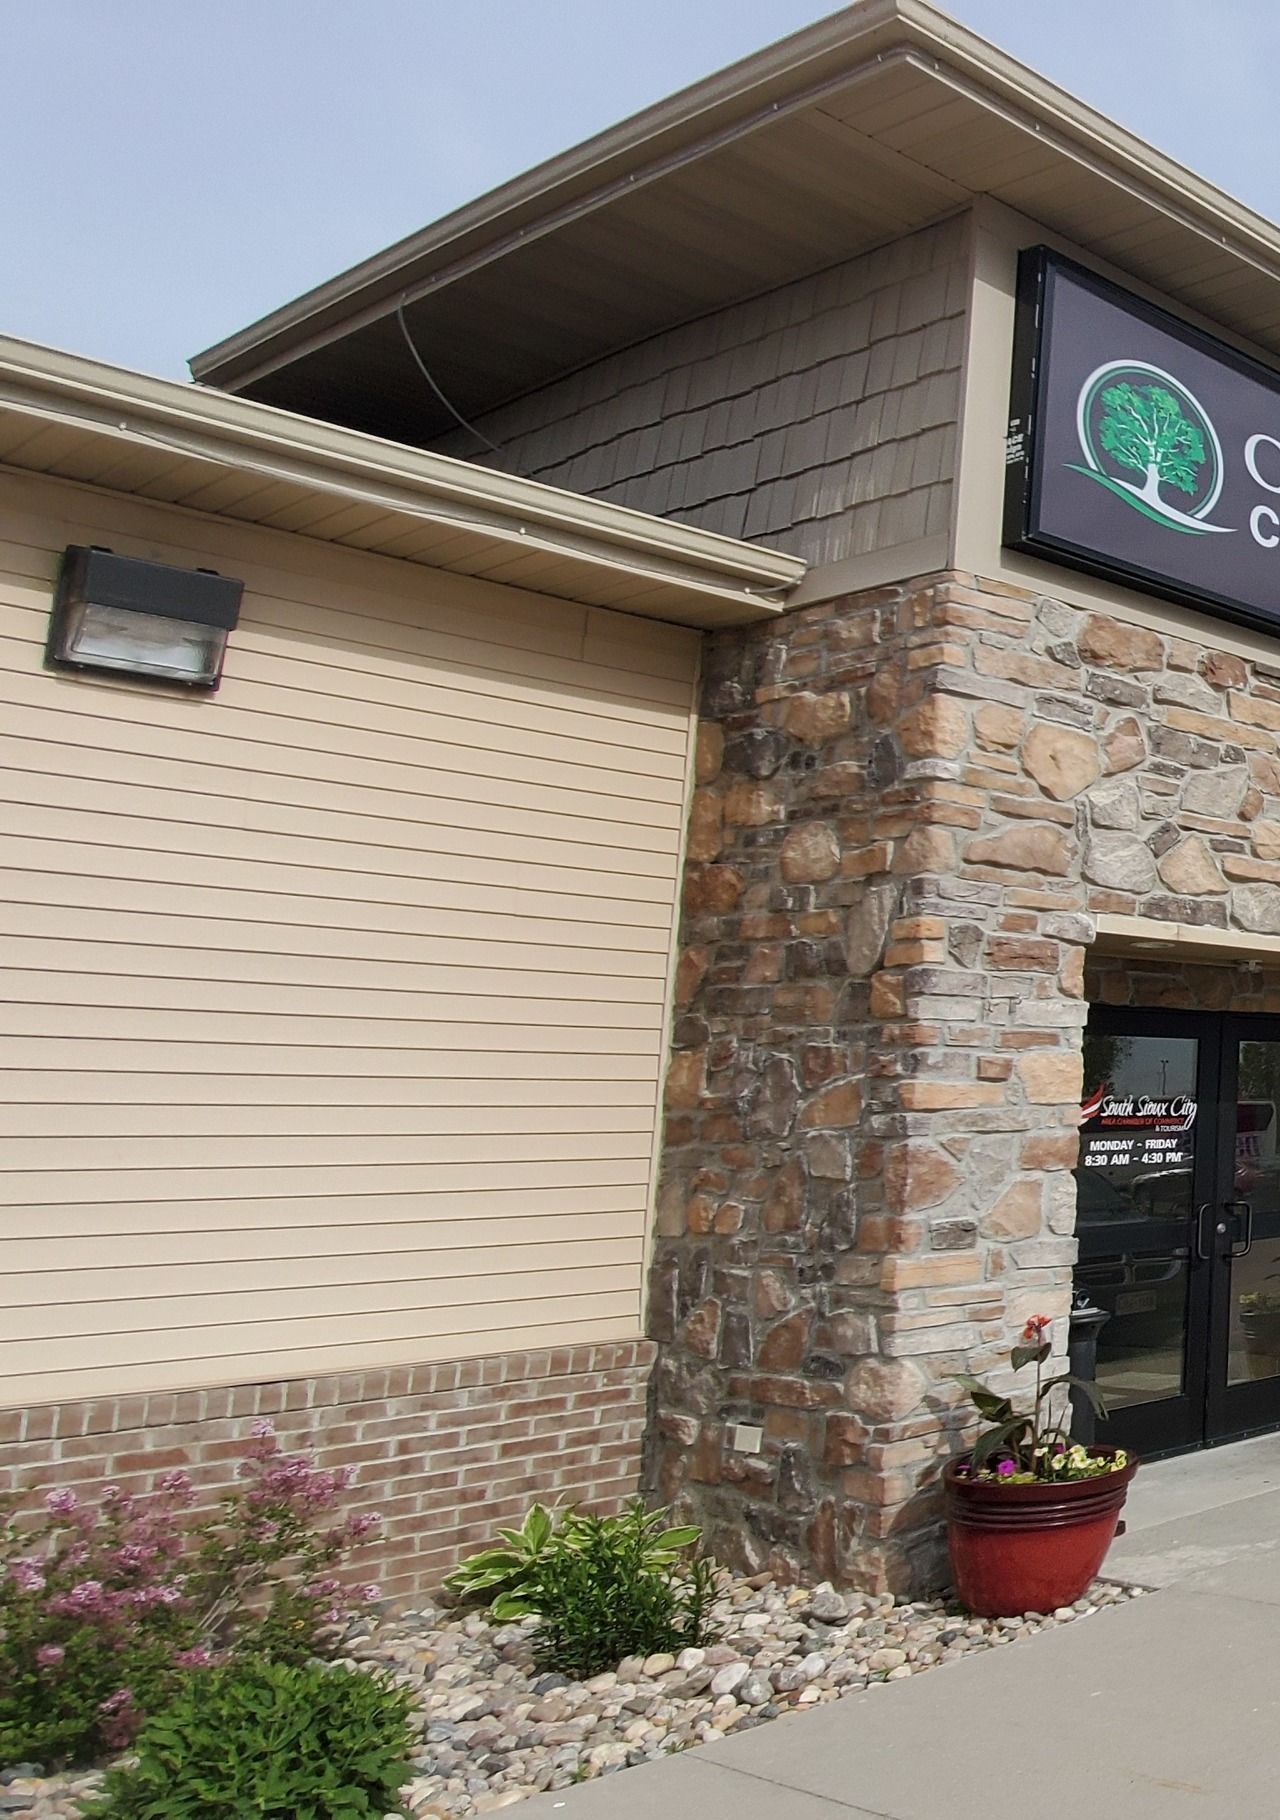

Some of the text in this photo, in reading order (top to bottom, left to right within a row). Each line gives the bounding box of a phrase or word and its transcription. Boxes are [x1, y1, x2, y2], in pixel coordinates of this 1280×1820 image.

[1100, 1094, 1198, 1131] South Sioux City
[1089, 1139, 1135, 1151] MONDAY
[1145, 1138, 1178, 1150] FRIDAY
[1084, 1154, 1108, 1167] 8:30
[1110, 1153, 1130, 1166] AM
[1141, 1152, 1163, 1164] 4:30
[1165, 1152, 1182, 1163] PM
